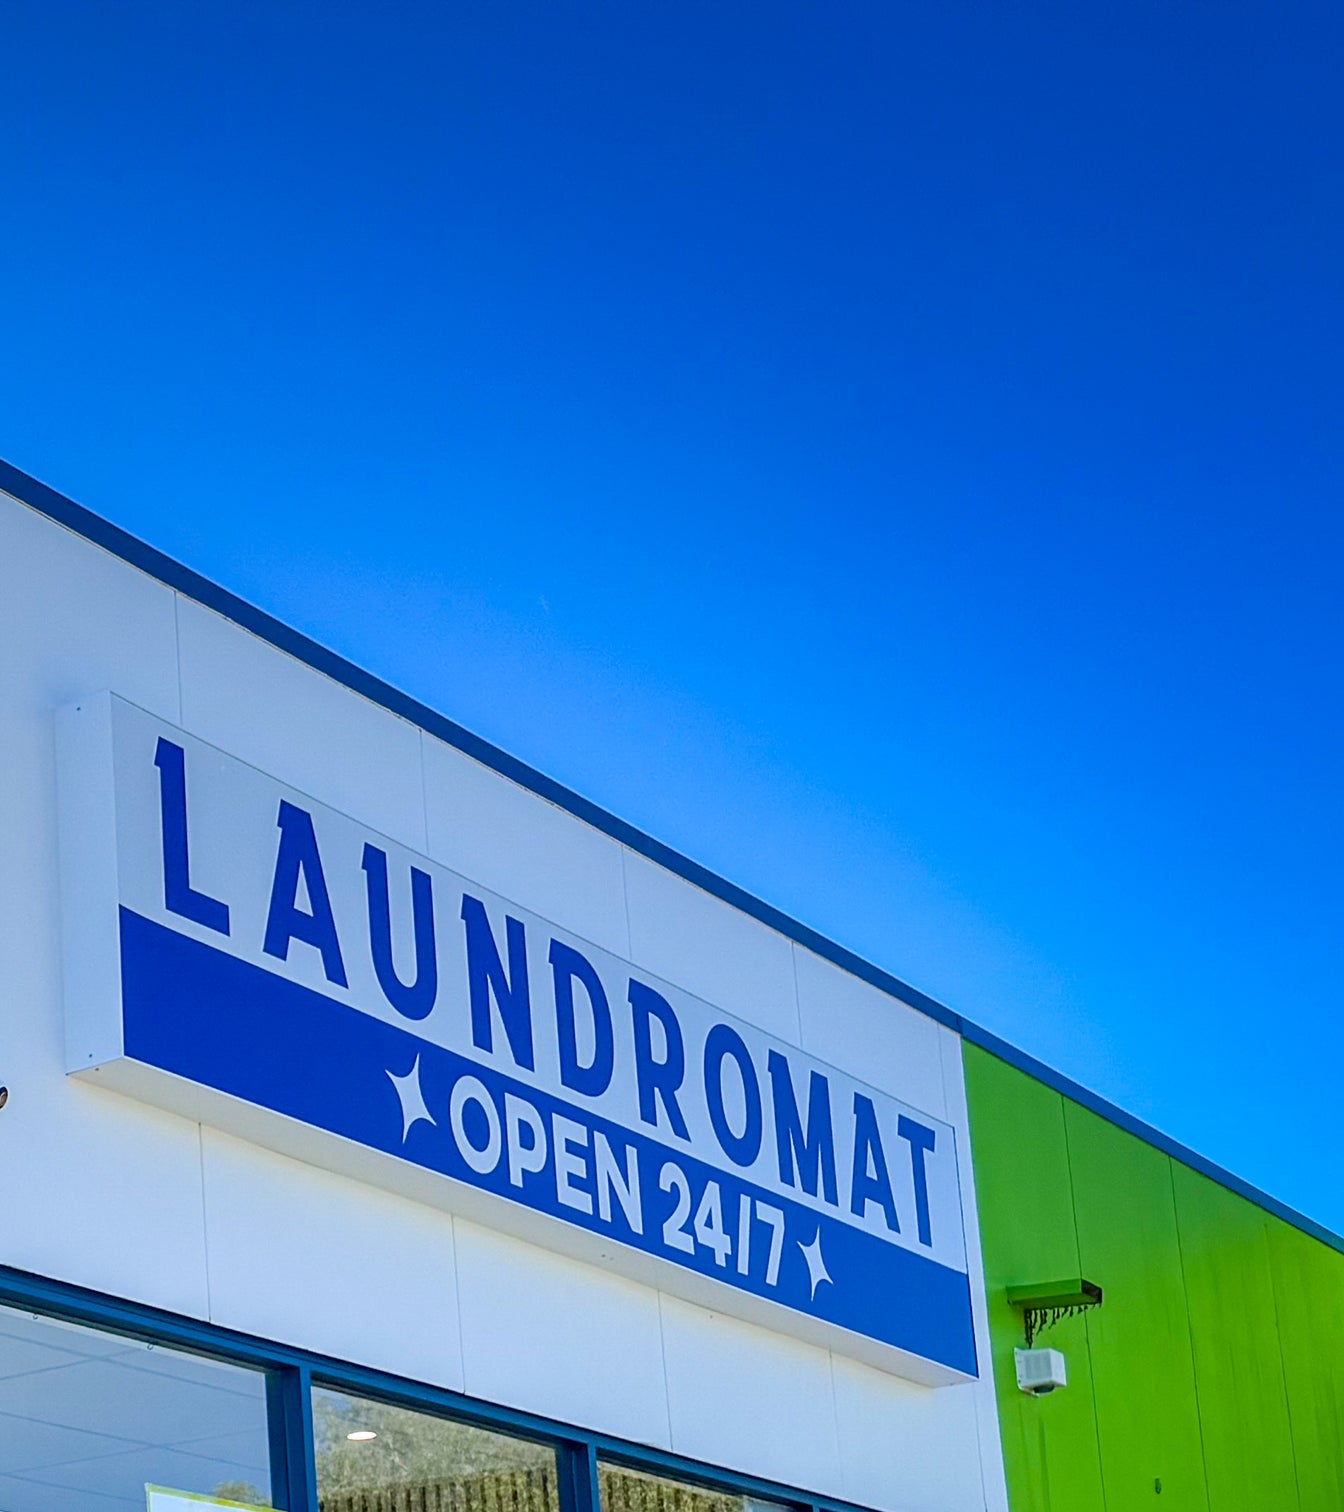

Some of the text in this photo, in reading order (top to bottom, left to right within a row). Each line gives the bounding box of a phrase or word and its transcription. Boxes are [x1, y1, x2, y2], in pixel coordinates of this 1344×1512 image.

[154, 736, 937, 1249] LAUNDROMAT
[449, 1075, 787, 1287] OPEN 24/7
